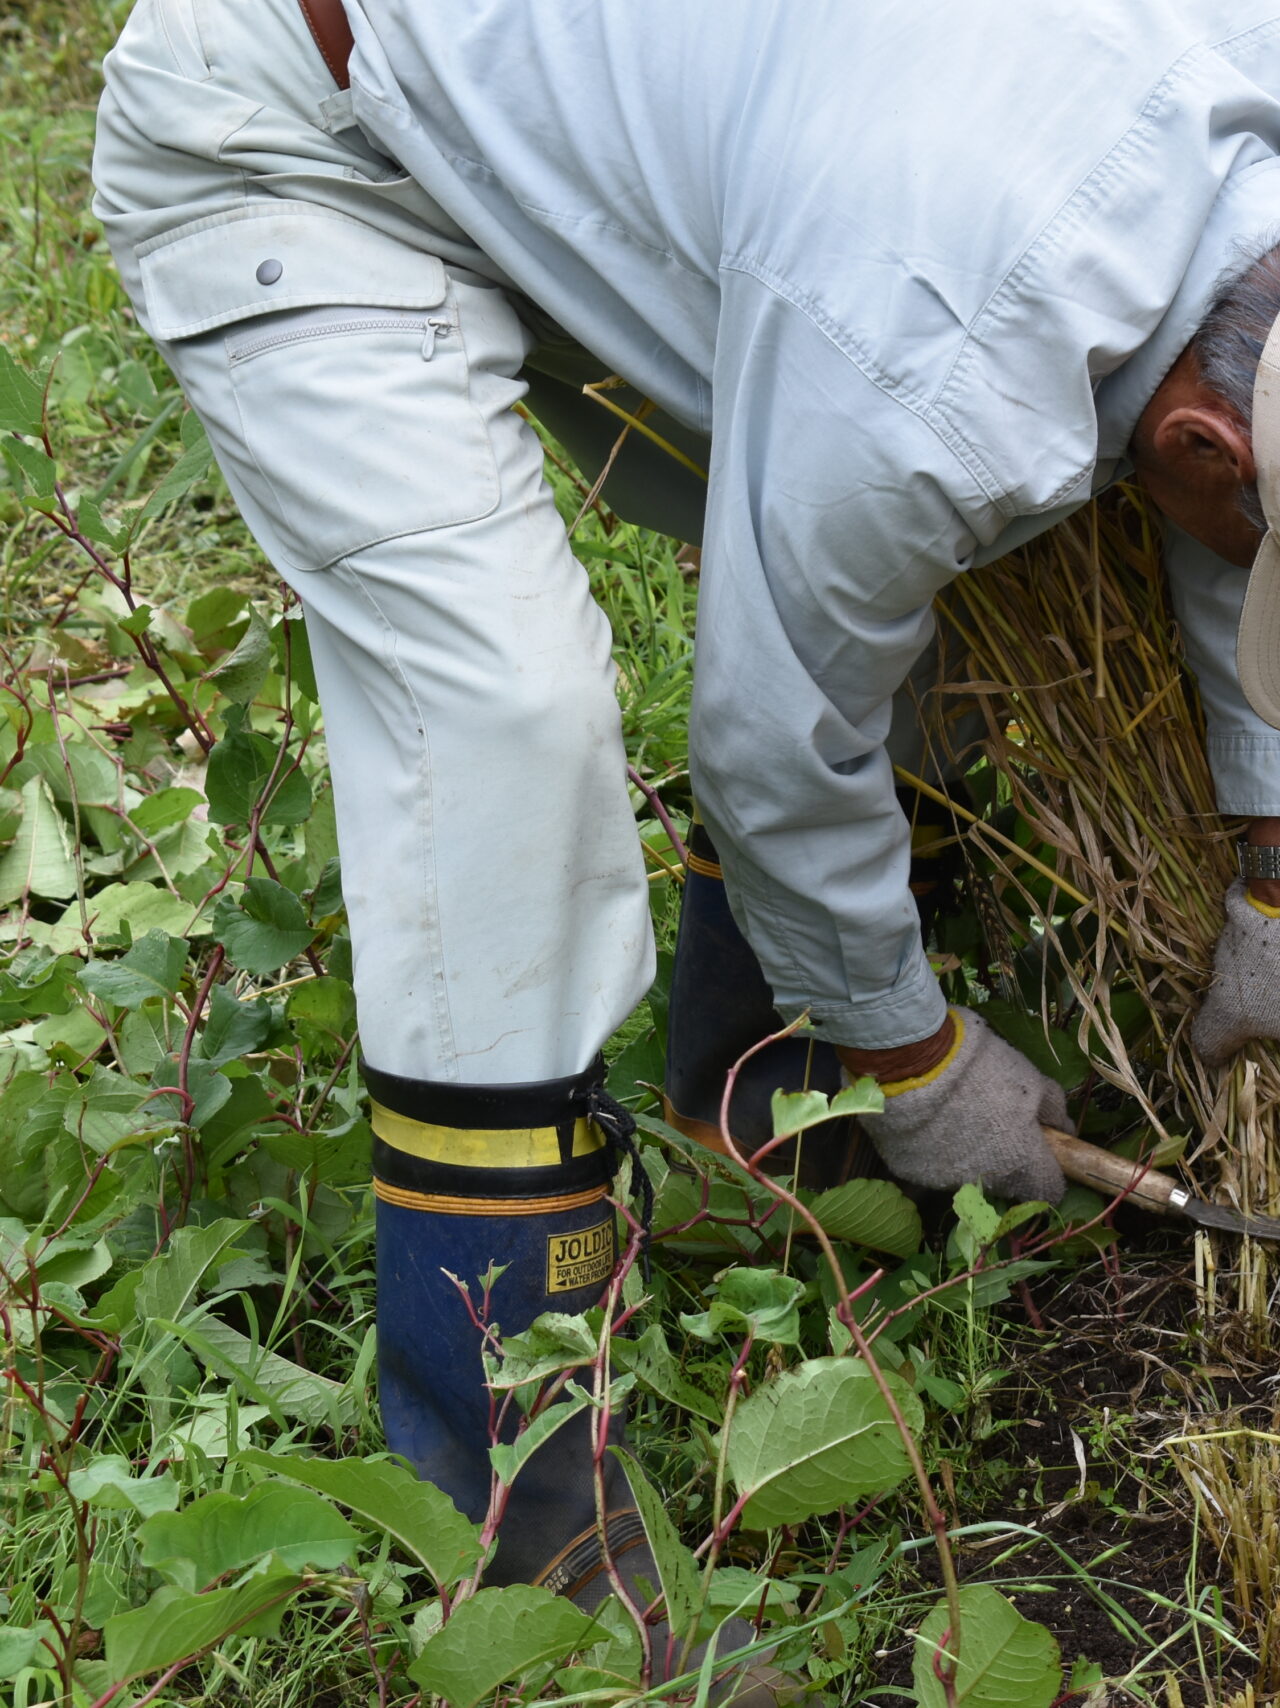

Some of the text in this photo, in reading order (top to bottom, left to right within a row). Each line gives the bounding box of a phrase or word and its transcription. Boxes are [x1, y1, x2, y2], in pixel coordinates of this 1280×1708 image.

[555, 1224, 612, 1263] JOLDIC
[556, 1268, 571, 1279] FOR
[572, 1260, 602, 1275] OUTDOOR
